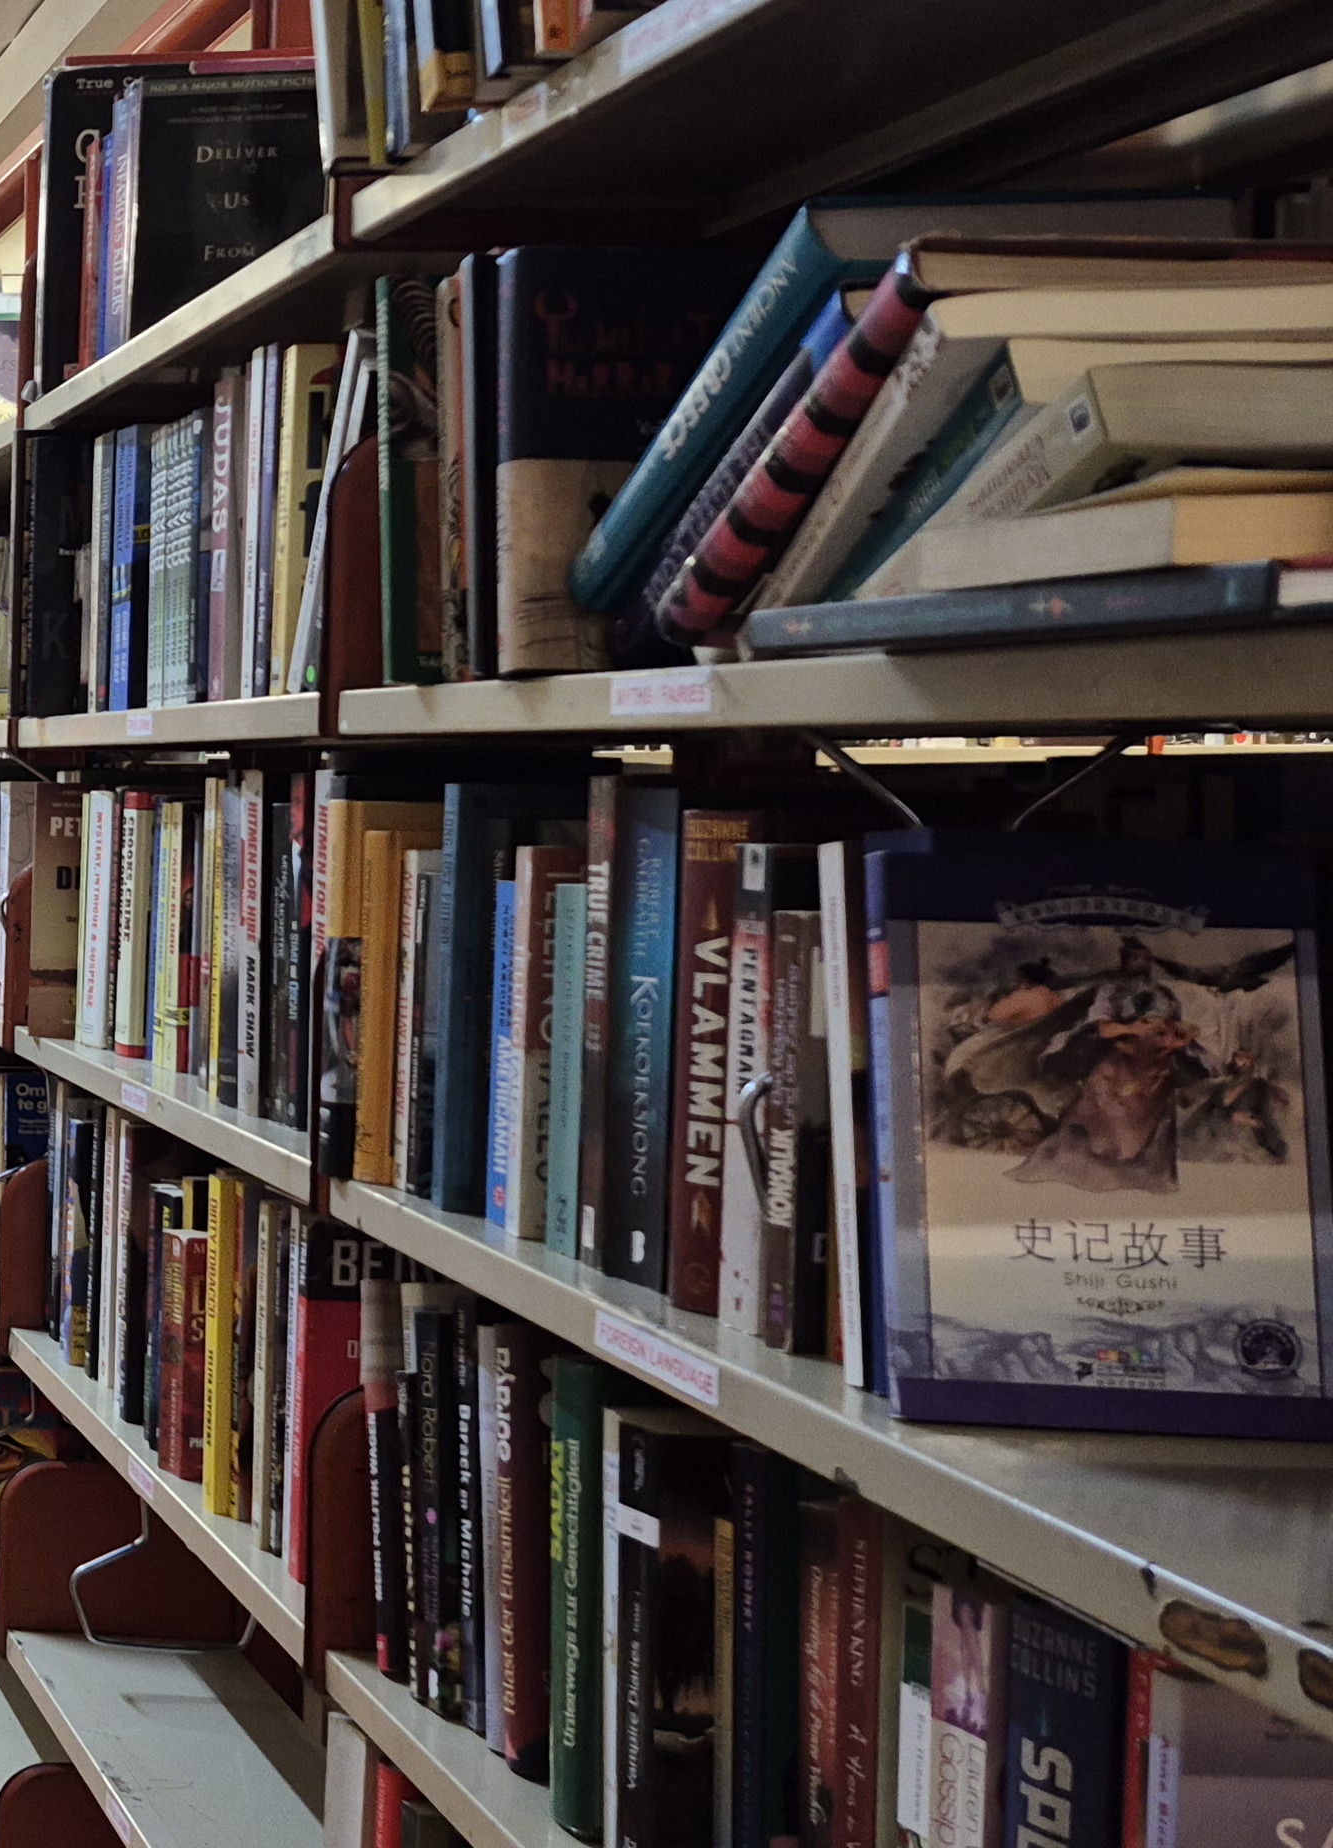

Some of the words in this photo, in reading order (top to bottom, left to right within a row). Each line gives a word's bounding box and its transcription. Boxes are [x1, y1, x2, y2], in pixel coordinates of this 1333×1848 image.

[76, 78, 114, 90] True
[196, 145, 277, 164] DELIVER
[112, 152, 129, 242] INFAMOUS
[109, 245, 125, 315] KILLERS
[204, 243, 258, 262] FROM
[208, 394, 234, 533] JUDAS
[92, 811, 104, 869] MYSTERY,
[124, 815, 136, 882] CROOKS,
[246, 801, 259, 863] HITMEN
[315, 804, 329, 874] HITMEN
[90, 873, 101, 928] INTRIGUE
[245, 867, 258, 900] FOR
[314, 878, 326, 914] FOR
[585, 860, 608, 924] TRUE
[122, 888, 133, 942] CRIME
[244, 904, 257, 943] HIRE
[85, 946, 96, 1007] SUSPENSE
[243, 955, 258, 1005] MARK
[581, 931, 605, 1001] CRIME
[241, 1009, 256, 1058] SHAW
[685, 936, 728, 1187] VLAMMEN
[491, 1034, 510, 1174] AMERICANAH
[768, 1129, 799, 1228] KONSALIK
[207, 1197, 219, 1244] DIRTY
[1009, 1217, 1227, 1268] 史记故事
[84, 1273, 93, 1333] PRETORIA
[205, 1248, 217, 1318] TOBACCO
[1063, 1271, 1107, 1290] Shiji
[1117, 1272, 1178, 1291] Gushi
[419, 1341, 437, 1398] Nora
[599, 1323, 650, 1367] FOREIGN
[650, 1345, 714, 1397] LANGUAGE
[364, 1411, 379, 1475] WAGEN
[420, 1406, 439, 1494] Roberts
[457, 1403, 472, 1484] Barack
[368, 1478, 383, 1546] POLITIK
[458, 1488, 472, 1511] en
[563, 1437, 584, 1589] Gerechtigkeit
[458, 1517, 472, 1617] Michelle
[496, 1477, 514, 1601] Einsamkeit
[372, 1549, 386, 1601] MEHR
[500, 1607, 514, 1645] der
[565, 1591, 578, 1626] zur
[562, 1631, 580, 1748] Unterwegs
[627, 1640, 641, 1708] Diaries
[845, 1635, 866, 1687] KING
[1010, 1645, 1098, 1698] COLLINS
[625, 1712, 640, 1790] Vampire
[938, 1731, 963, 1846] Gossip
